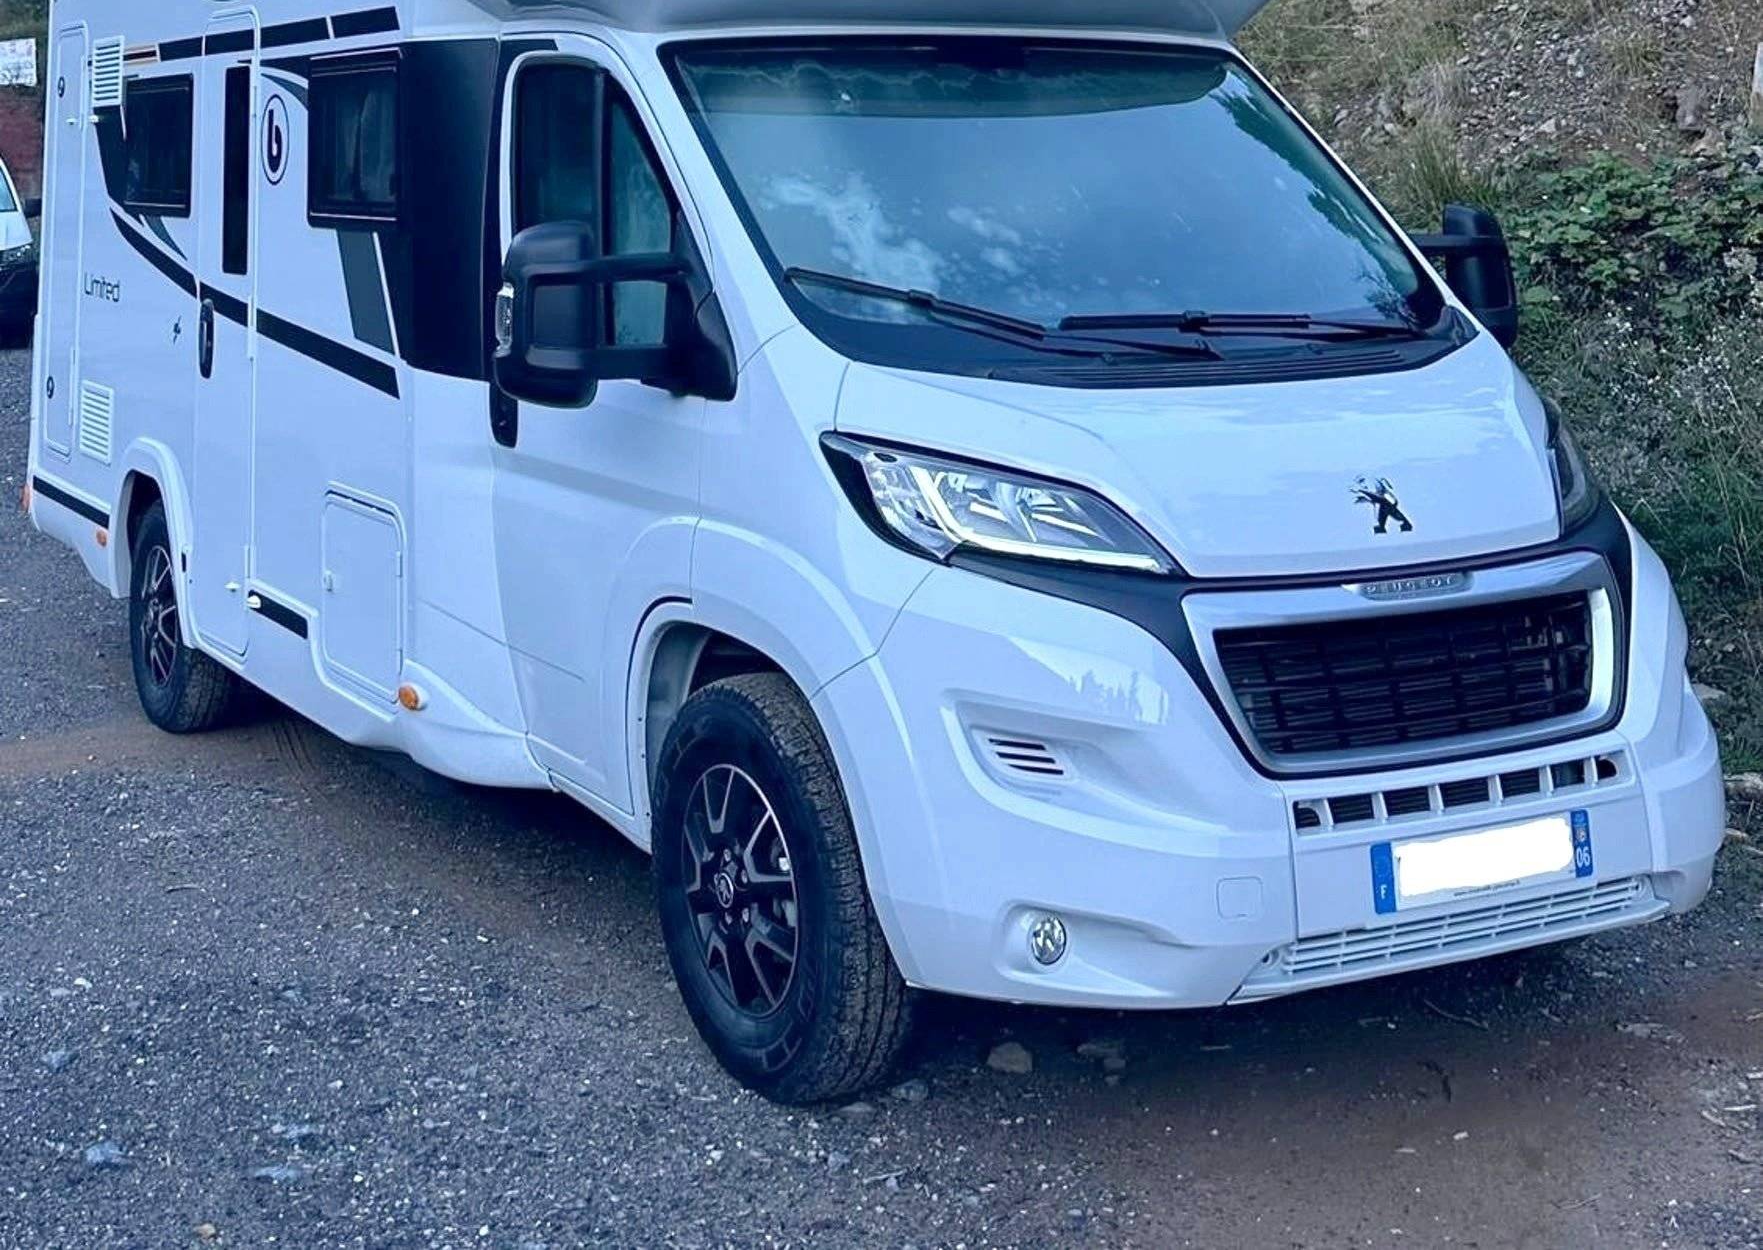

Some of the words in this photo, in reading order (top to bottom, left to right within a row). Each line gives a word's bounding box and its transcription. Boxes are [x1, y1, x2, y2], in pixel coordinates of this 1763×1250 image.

[84, 272, 120, 302] Limited
[1576, 846, 1591, 868] 06
[1380, 883, 1387, 900] F
